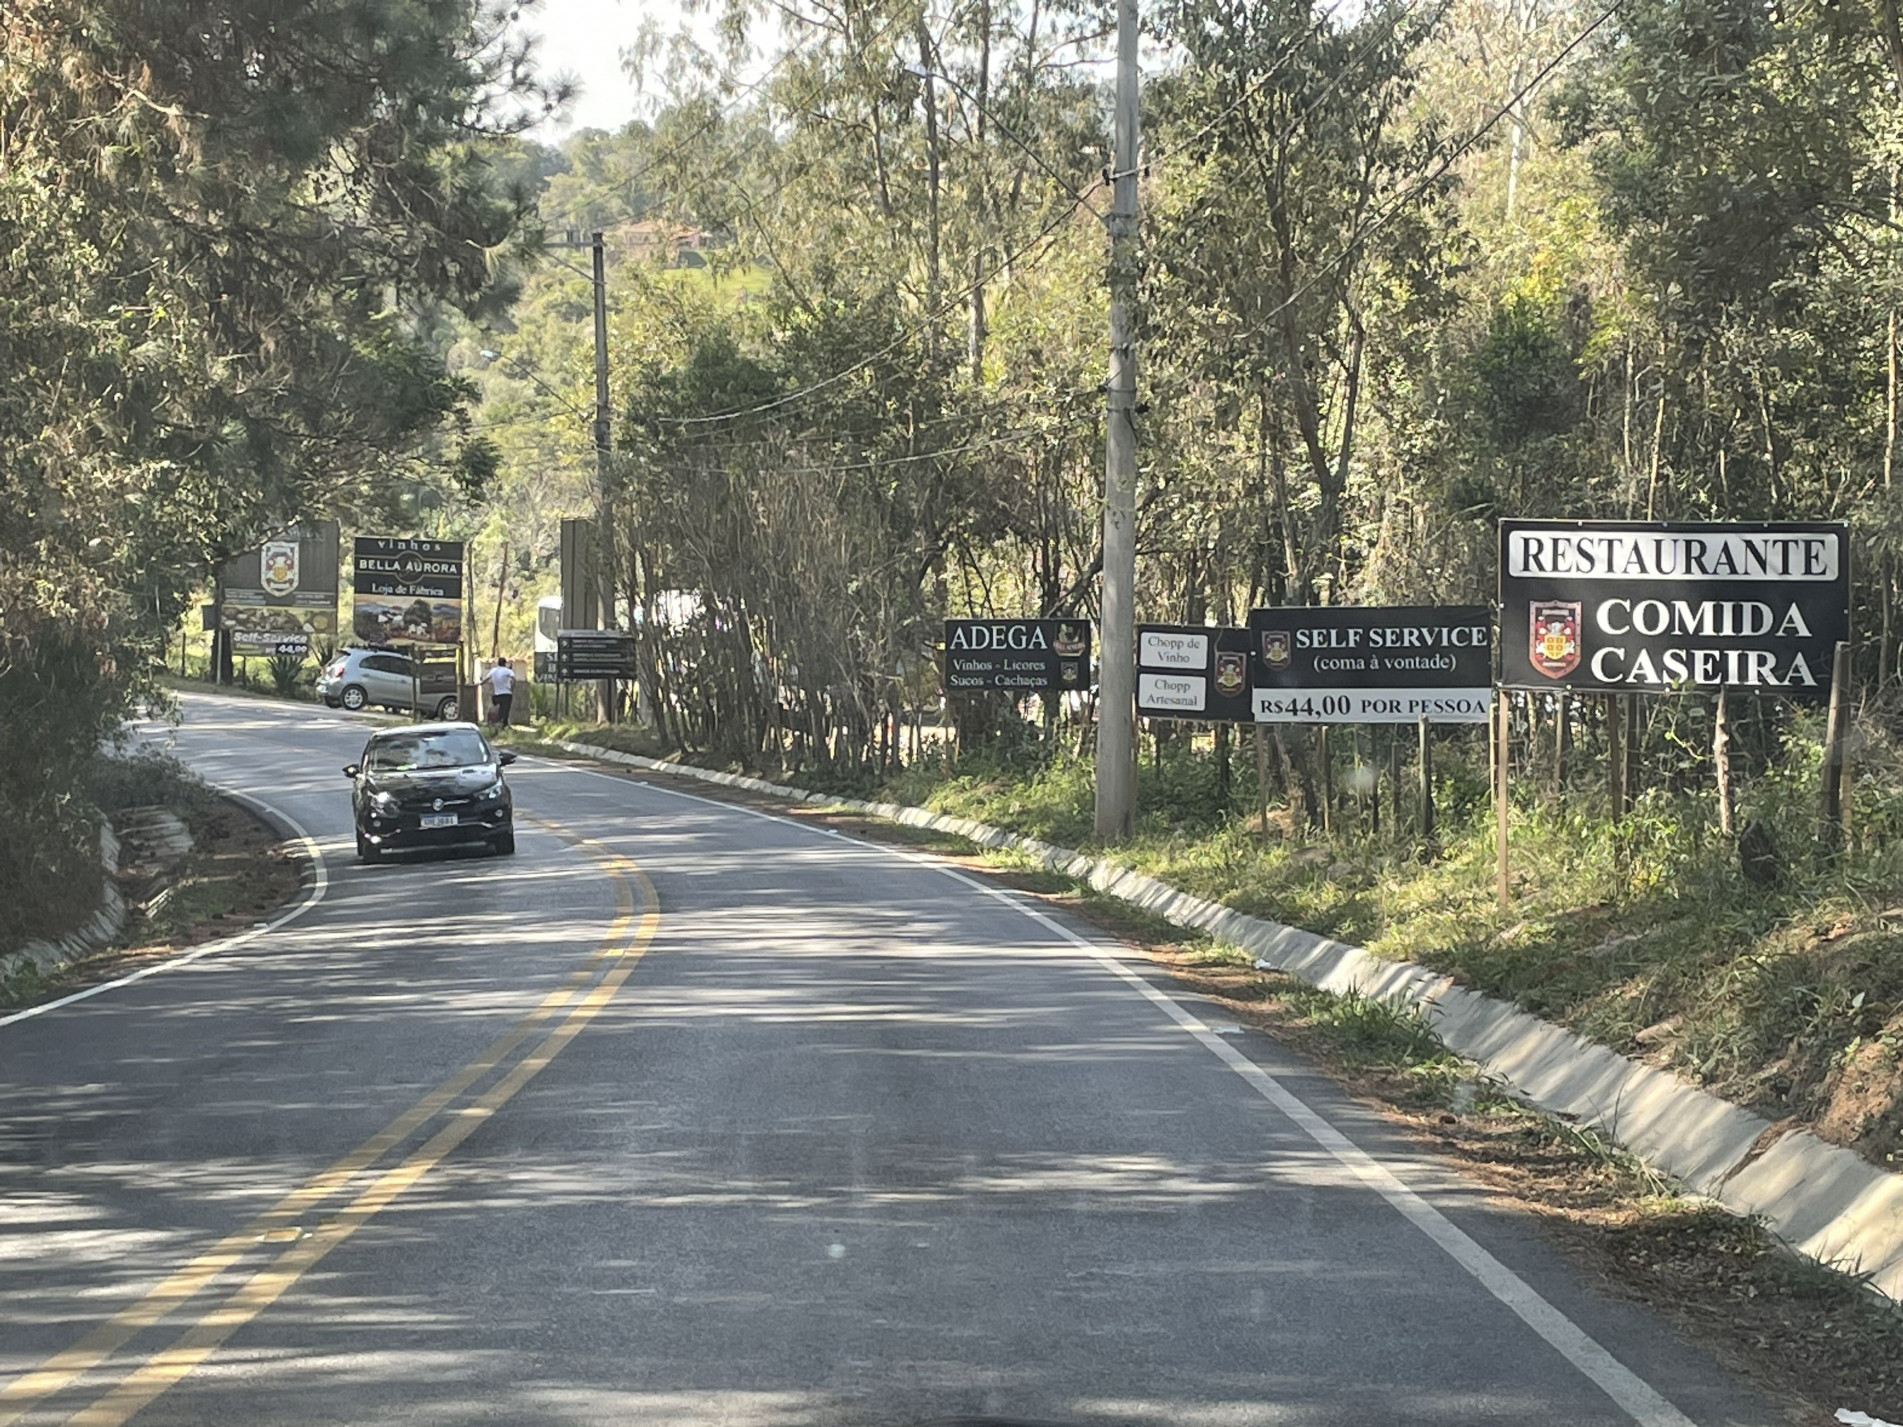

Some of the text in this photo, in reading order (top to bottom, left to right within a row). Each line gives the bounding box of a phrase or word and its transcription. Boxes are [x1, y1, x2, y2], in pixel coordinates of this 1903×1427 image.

[1520, 536, 1828, 576] RESTAURANTE
[359, 559, 458, 574] BELLA AURORA
[371, 583, 444, 597] Loja de Fábrica
[1596, 598, 1813, 637] COMIDA
[949, 625, 1048, 650] ADEGA
[1147, 635, 1201, 650] Chopp de
[1295, 626, 1488, 649] SELF SERVICE
[953, 659, 993, 671] Vinhos
[1003, 658, 1046, 671] Licores
[1158, 651, 1190, 663] Vinho
[1313, 653, 1457, 673] (coma à vontade)
[1590, 646, 1820, 688] CASEIRA
[950, 674, 984, 687] Sucos
[994, 674, 1048, 688] Cachaças
[1154, 678, 1191, 694] Chopp
[1146, 694, 1198, 706] Artesanal
[1260, 694, 1487, 719] R$44,00 POR PESSOA
